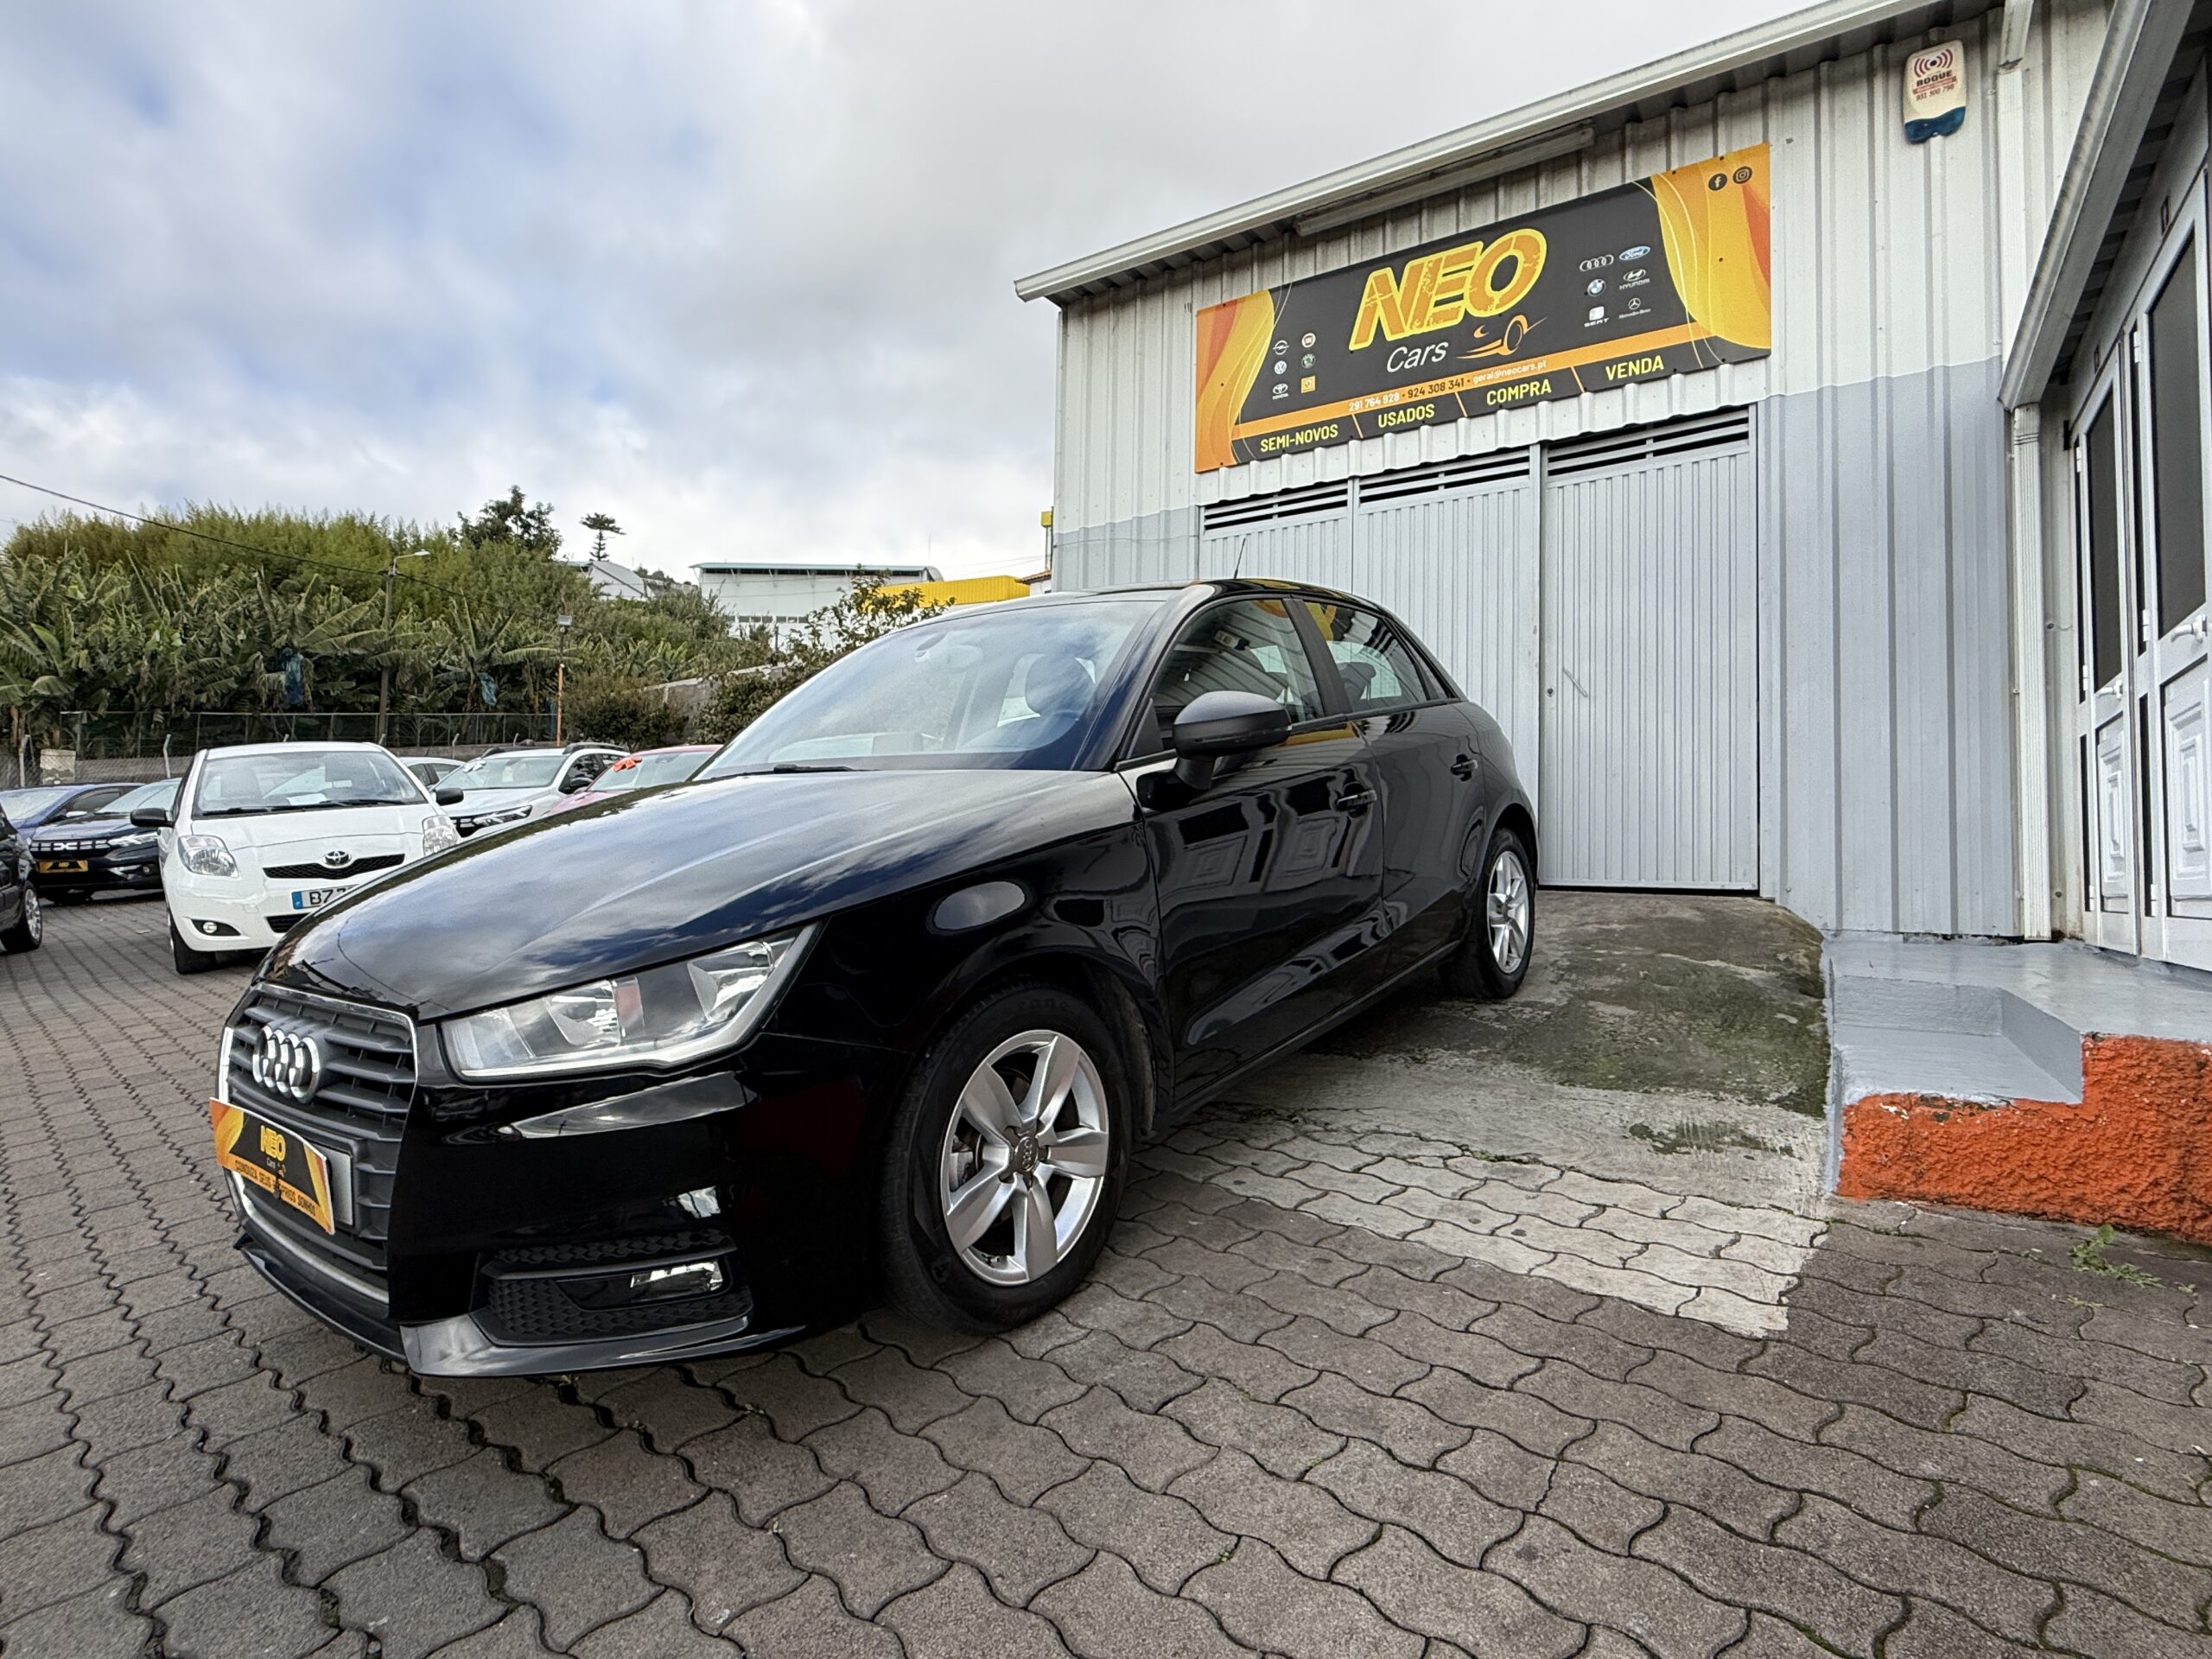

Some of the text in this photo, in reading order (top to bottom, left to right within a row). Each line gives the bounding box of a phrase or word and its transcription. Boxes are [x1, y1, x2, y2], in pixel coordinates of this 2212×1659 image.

[1916, 70, 1952, 86] ROQUE
[1349, 228, 1547, 351] NEO
[1619, 278, 1650, 289] HYUNDAI
[1584, 317, 1609, 327] SEAT
[1387, 341, 1449, 372] Cars
[1348, 360, 1547, 412] 291 764 928 924 308 341 geral@neocars.pt
[1261, 355, 1664, 452] SEMI-NOVOS USADOS COMPRA VENDA
[261, 1125, 286, 1162] NEO
